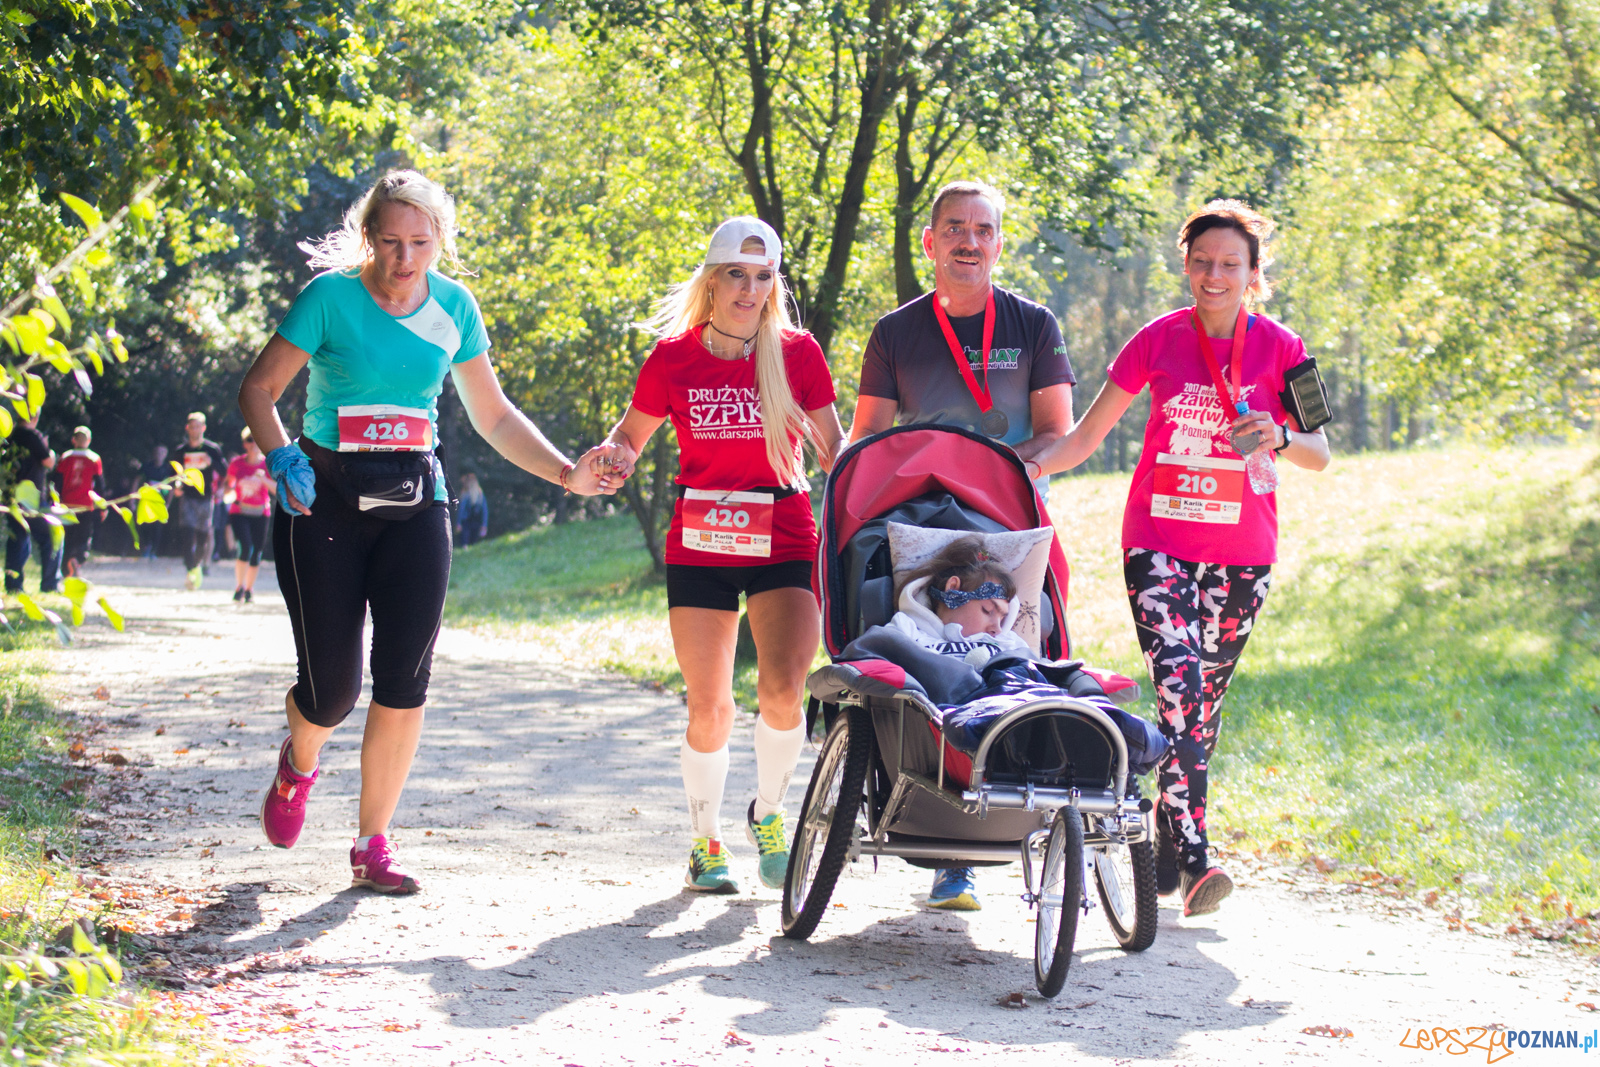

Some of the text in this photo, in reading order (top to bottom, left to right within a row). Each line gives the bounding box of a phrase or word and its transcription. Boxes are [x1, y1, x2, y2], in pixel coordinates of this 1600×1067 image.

[1053, 346, 1067, 356] MU
[1184, 382, 1200, 393] 2017
[1178, 393, 1223, 410] zaws
[690, 401, 762, 428] SZPIK
[363, 422, 409, 440] 426
[1177, 474, 1218, 495] 210
[703, 508, 750, 529] 420
